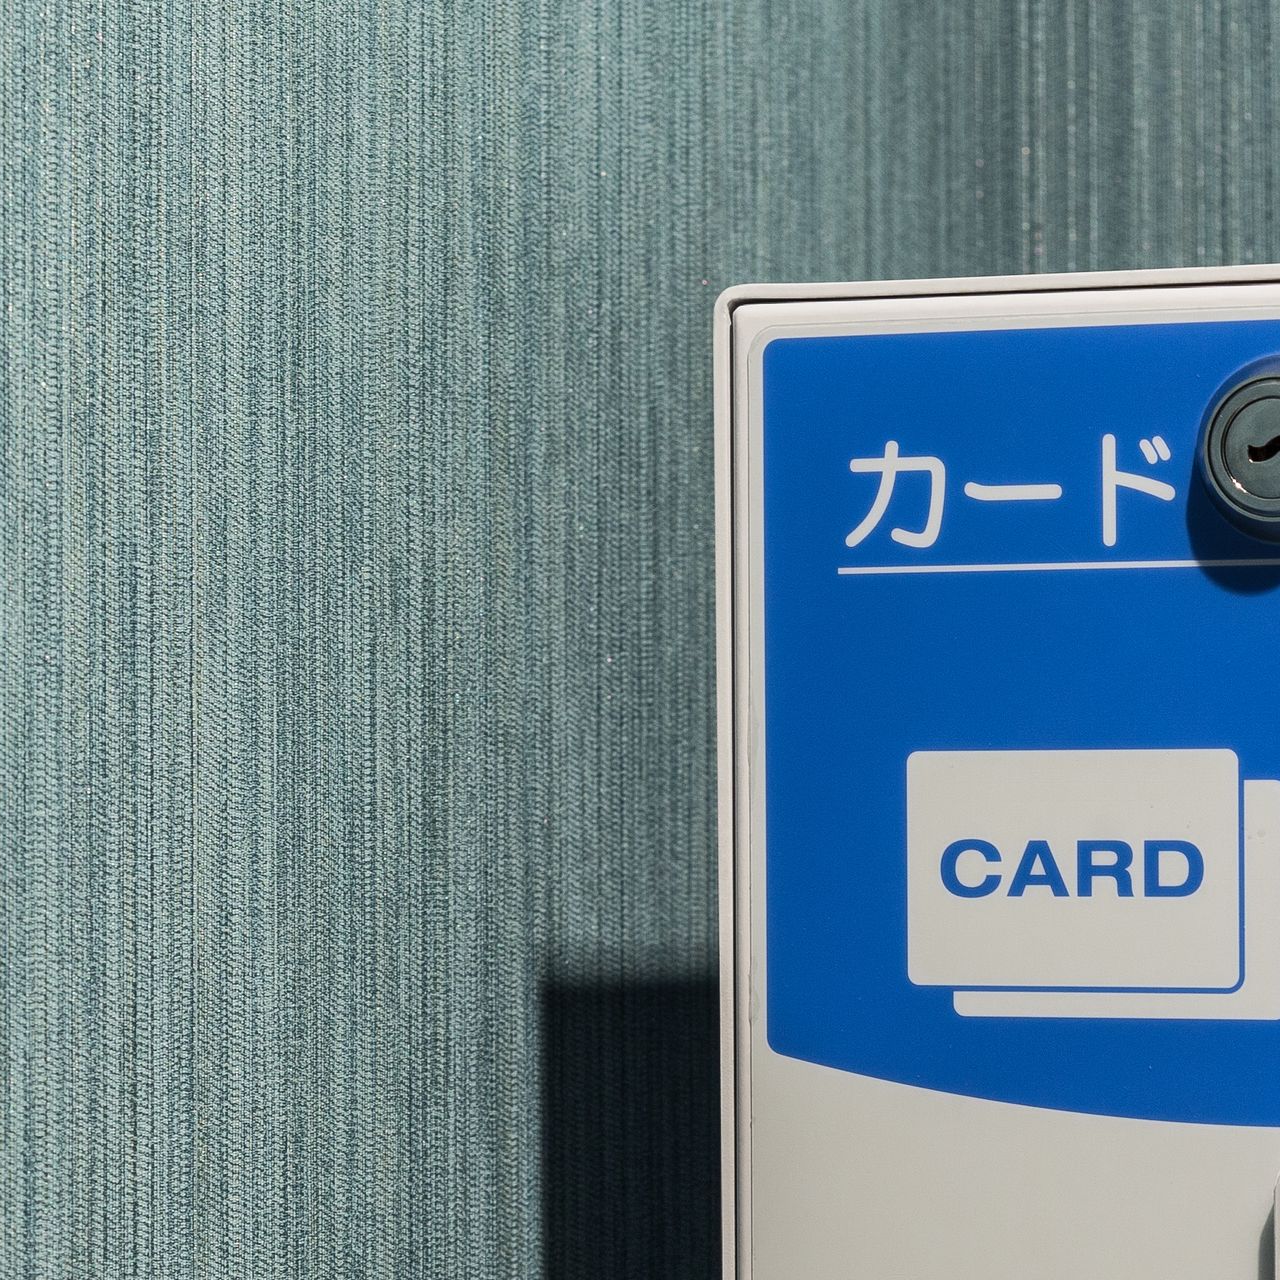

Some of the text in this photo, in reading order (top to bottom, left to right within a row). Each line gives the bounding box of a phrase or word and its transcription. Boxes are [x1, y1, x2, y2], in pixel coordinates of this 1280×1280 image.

[844, 431, 1177, 548] カード
[940, 838, 1205, 898] CARD
